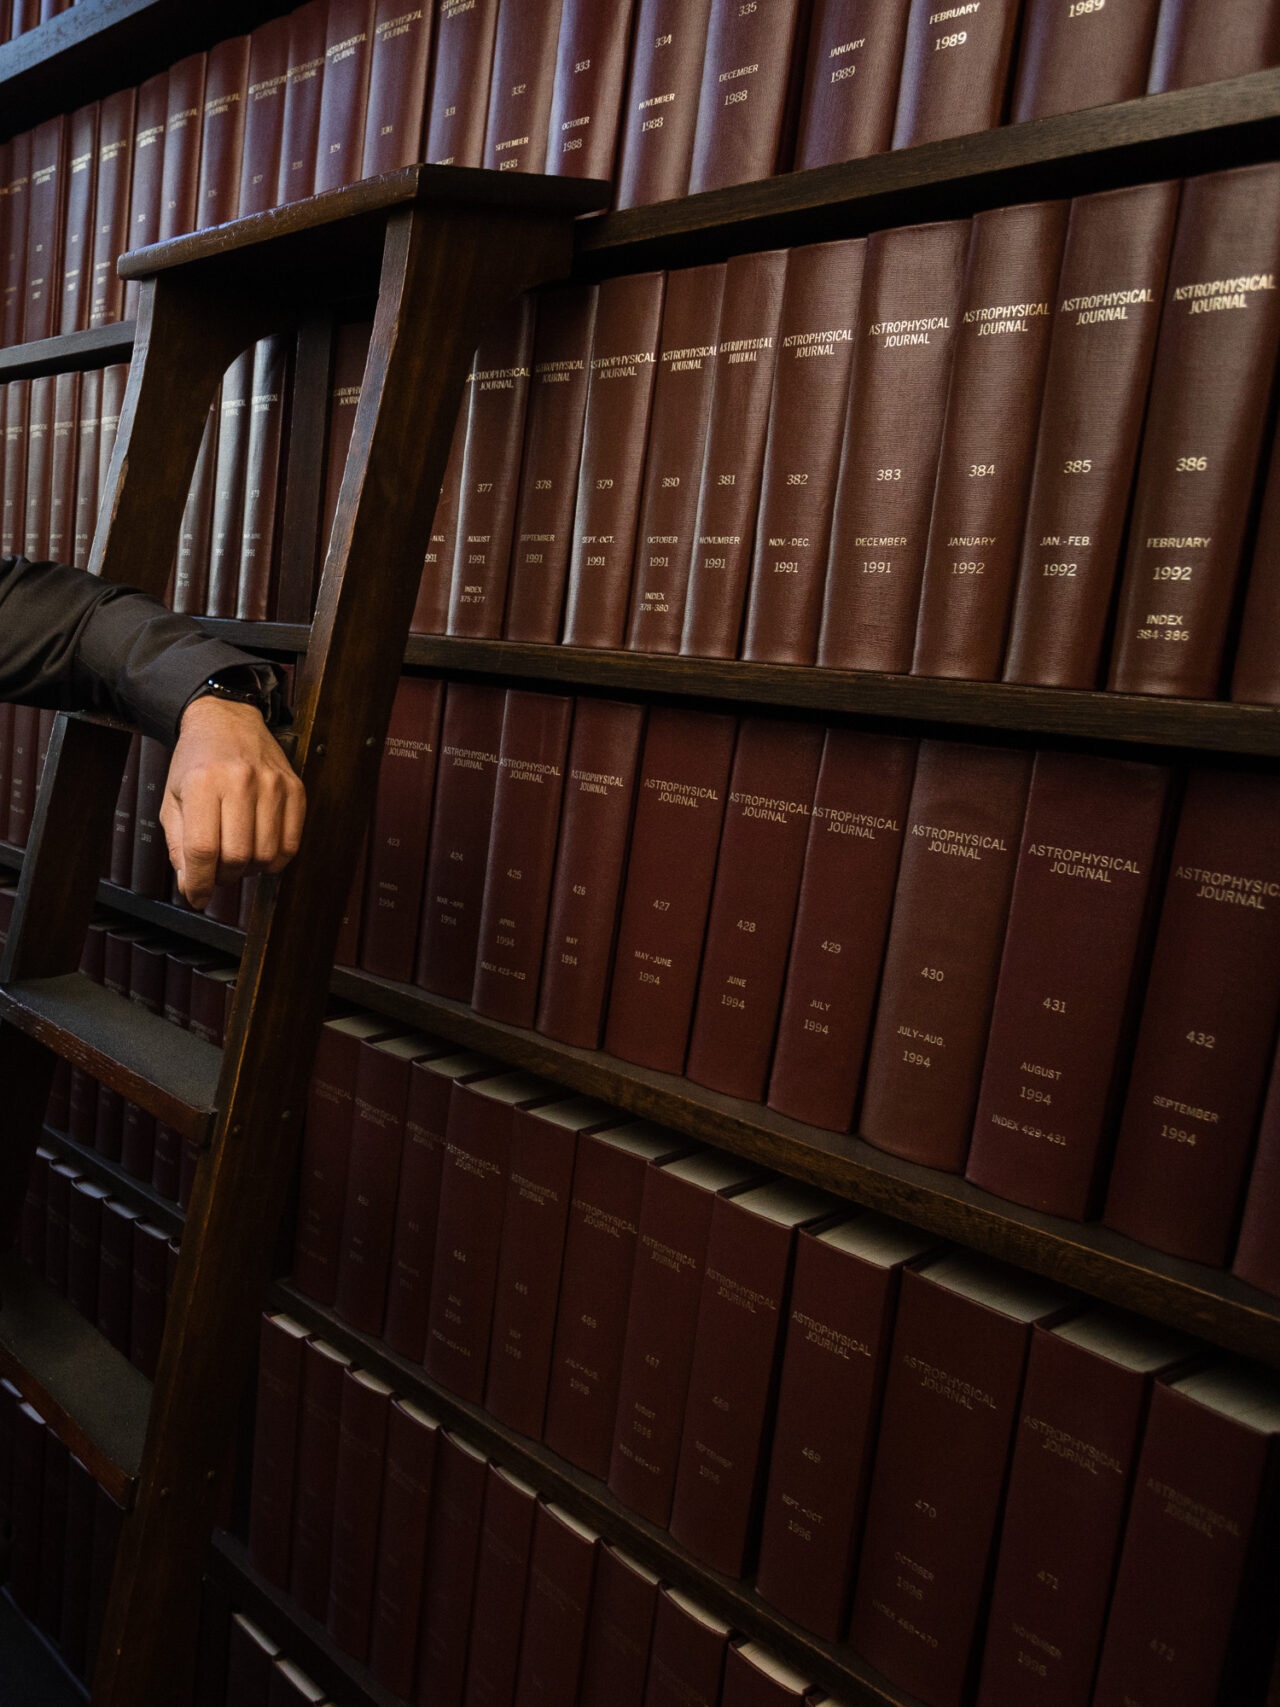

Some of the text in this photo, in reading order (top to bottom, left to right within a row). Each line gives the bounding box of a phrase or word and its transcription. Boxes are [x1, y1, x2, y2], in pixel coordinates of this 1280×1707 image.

[738, 1, 759, 17] 335
[929, 2, 980, 24] FEBRUARY
[1067, 0, 1106, 18] 1989
[655, 34, 673, 48] 334
[828, 38, 865, 57] JANUARY
[934, 31, 968, 50] 1989
[574, 60, 591, 73] 333
[718, 64, 759, 83] DECEMBER
[830, 65, 856, 83] 1989
[638, 93, 675, 110] NOVEMBER
[723, 90, 748, 106] 1988
[562, 116, 590, 130] OCTOBER
[640, 117, 664, 132] 1988
[562, 138, 583, 152] 1988
[1173, 272, 1276, 301] ASTROPHYSICAL
[1061, 288, 1154, 312] ASTROPHYSICAL
[1188, 292, 1248, 315] JOURNAL
[963, 302, 1050, 324] ASTROPHYSICAL
[1075, 305, 1129, 326] JOURNAL
[869, 316, 950, 337] ASTROPHYSICAL
[977, 319, 1029, 337] JOURNAL
[720, 336, 773, 354] ASTROPHYSICAL
[782, 328, 854, 348] ASTROPHYSICAL
[883, 331, 932, 348] JOURNAL
[661, 346, 717, 363] ASTROPHYSICAL
[727, 350, 757, 365] JOURNAL
[794, 343, 835, 359] JOURNAL
[590, 353, 657, 370] ASTROPHYSICAL
[669, 358, 703, 372] JOURNAL
[466, 366, 531, 383] ASTROPHYSICAL
[598, 366, 638, 380] JOURNAL
[479, 379, 515, 391] JOURNAL
[968, 464, 996, 478] 384
[1063, 459, 1093, 474] 385
[1175, 456, 1209, 473] 386
[661, 476, 680, 489] 380
[717, 474, 736, 487] 381
[786, 473, 809, 486] 382
[876, 468, 902, 482] 383
[477, 482, 493, 494] 377
[535, 479, 552, 491] 378
[596, 478, 614, 491] 379
[467, 534, 491, 544] AUGUST
[520, 533, 555, 544] SEPTEMBER
[646, 535, 678, 545] OCTOBER
[699, 535, 741, 546] NOVEMBER
[768, 537, 811, 548] NOV.-DEC.
[854, 536, 907, 547] DECEMBER
[947, 536, 996, 547] JANUARY
[1146, 536, 1211, 549] FEBRUARY
[468, 554, 486, 565] 1991
[525, 553, 543, 565] 1991
[585, 556, 606, 568] 1991
[649, 556, 669, 569] 1991
[703, 557, 727, 570] 1991
[862, 560, 892, 574] 1991
[773, 561, 799, 574] 1991
[951, 561, 985, 575] 1992
[1042, 562, 1078, 577] 1992
[1152, 566, 1192, 581] 1992
[644, 592, 665, 601] INDEX
[1146, 614, 1183, 627] INDEX
[1136, 628, 1190, 642] 384-386
[387, 748, 419, 760] JOURNAL
[443, 745, 499, 764] ASTROPHYSICAL
[452, 757, 485, 771] JOURNAL
[499, 756, 561, 776] ASTROPHYSICAL
[509, 769, 545, 784] JOURNAL
[571, 770, 625, 788] ASTROPHYSICAL
[578, 781, 608, 796] JOURNAL
[644, 778, 718, 800] ASTROPHYSICAL
[658, 791, 700, 809] JOURNAL
[729, 791, 811, 816] ASTROPHYSICAL
[741, 805, 790, 824] JOURNAL
[812, 805, 900, 832] ASTROPHYSICAL
[827, 820, 876, 840] JOURNAL
[911, 824, 1008, 852] ASTROPHYSICAL
[927, 841, 982, 861] JOURNAL
[1028, 843, 1141, 874] ASTROPHYSICAL
[506, 867, 523, 881] 425
[1049, 861, 1112, 883] JOURNAL
[572, 883, 587, 896] 426
[1175, 866, 1280, 898] ASTROPHYSIC
[1196, 884, 1266, 910] JOURNAL
[652, 899, 671, 912] 427
[440, 914, 457, 927] 1994
[499, 917, 517, 929] APRIL
[736, 919, 757, 934] 428
[495, 934, 516, 948] 1994
[565, 936, 579, 946] MAY
[820, 940, 842, 955] 429
[560, 953, 578, 967] 1994
[634, 949, 673, 968] MAY-JUNE
[638, 971, 661, 986] 1994
[726, 975, 747, 988] JUNE
[920, 967, 945, 983] 430
[720, 994, 746, 1011] 1994
[809, 999, 832, 1013] JULY
[1042, 997, 1067, 1014] 431
[803, 1018, 830, 1036] 1994
[896, 1025, 947, 1049] JULY-AUG.
[1185, 1030, 1216, 1049] 432
[901, 1050, 932, 1069] 1994
[1020, 1061, 1062, 1081] AUGUST
[1019, 1085, 1052, 1106] 1994
[1152, 1094, 1220, 1125] SEPTEMBER
[991, 1113, 1067, 1147] INDEX 429-431
[1160, 1124, 1198, 1147] 1994
[583, 1214, 621, 1239] JOURNAL
[705, 1267, 777, 1311] ASTROPHYSICAL
[716, 1286, 757, 1314] JOURNAL
[792, 1310, 872, 1358] ASTROPHYSICAL
[805, 1331, 851, 1360] JOURNAL
[903, 1355, 997, 1409] ASTROPHYSICAL
[920, 1376, 973, 1410] JOURNAL
[1024, 1414, 1123, 1474] ASTROPHYSICAL
[1042, 1438, 1099, 1475] JOURNAL
[913, 1499, 937, 1519] 470
[894, 1551, 936, 1584] OCTOBER
